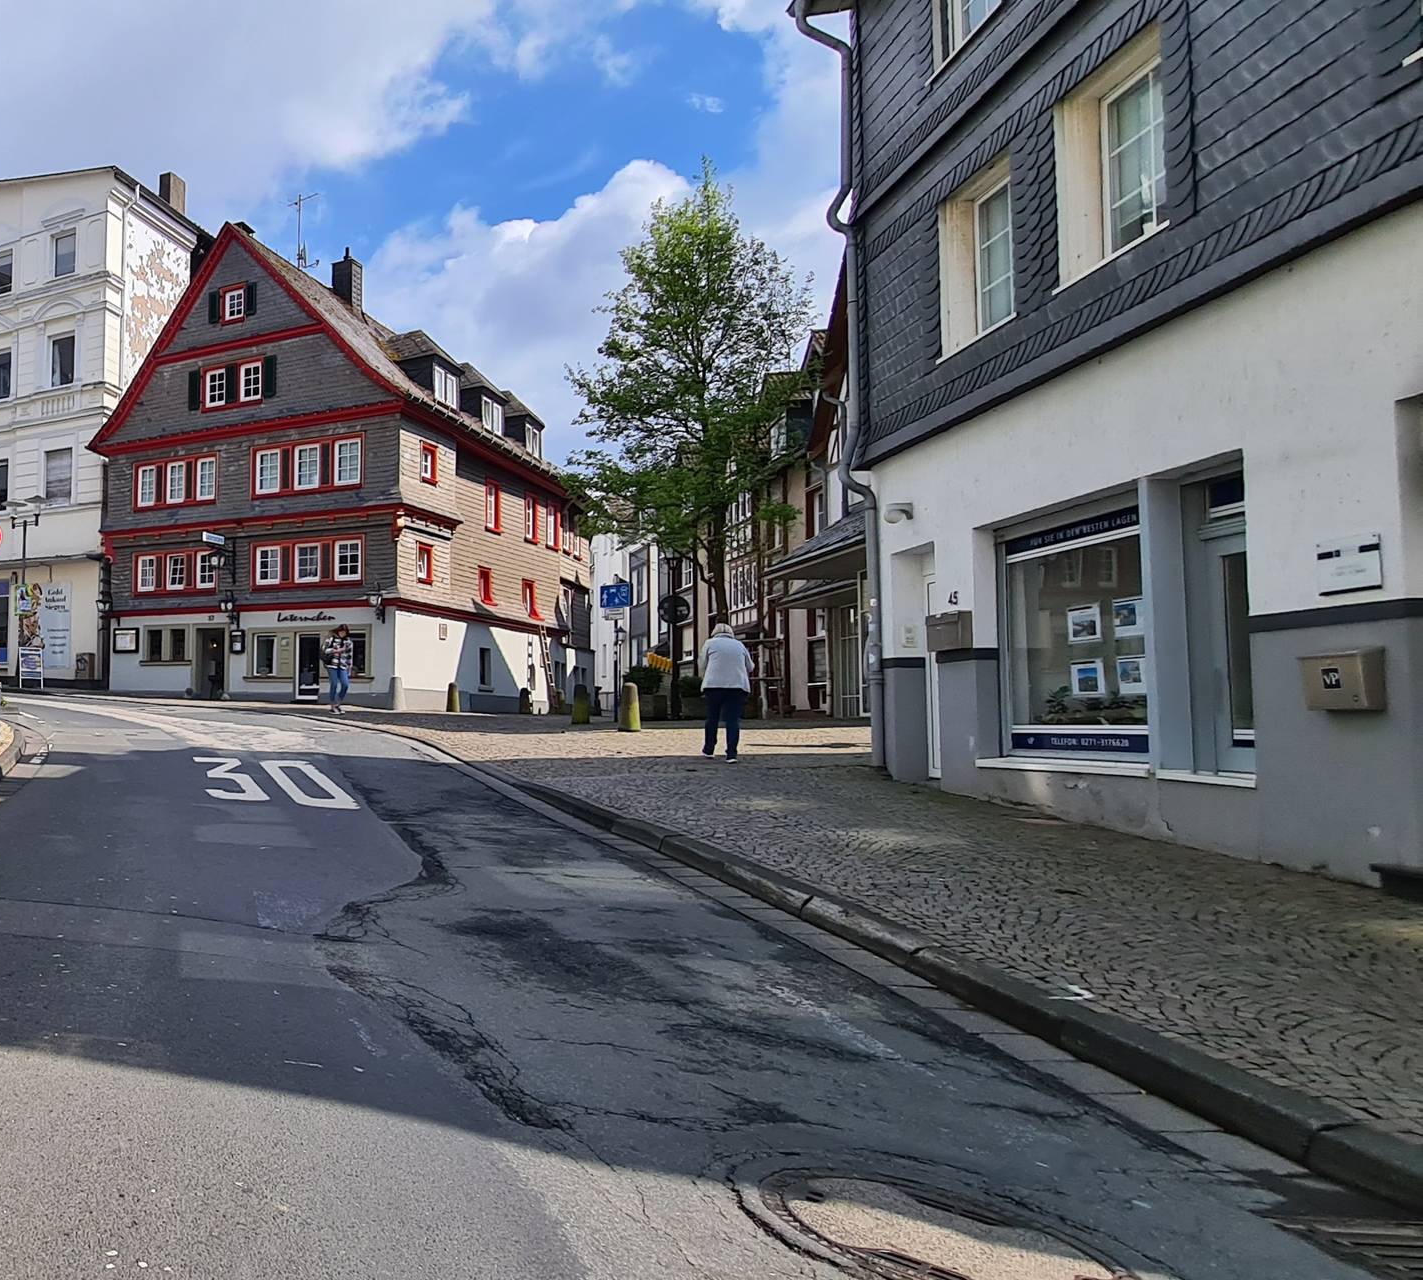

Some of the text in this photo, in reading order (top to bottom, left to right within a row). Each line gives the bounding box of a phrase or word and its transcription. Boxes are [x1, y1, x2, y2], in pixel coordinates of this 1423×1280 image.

[1111, 514, 1137, 527] LAGEN
[948, 591, 959, 605] 45
[277, 611, 336, 623] Laternchen
[1323, 672, 1339, 685] VP
[192, 756, 361, 810] 30
